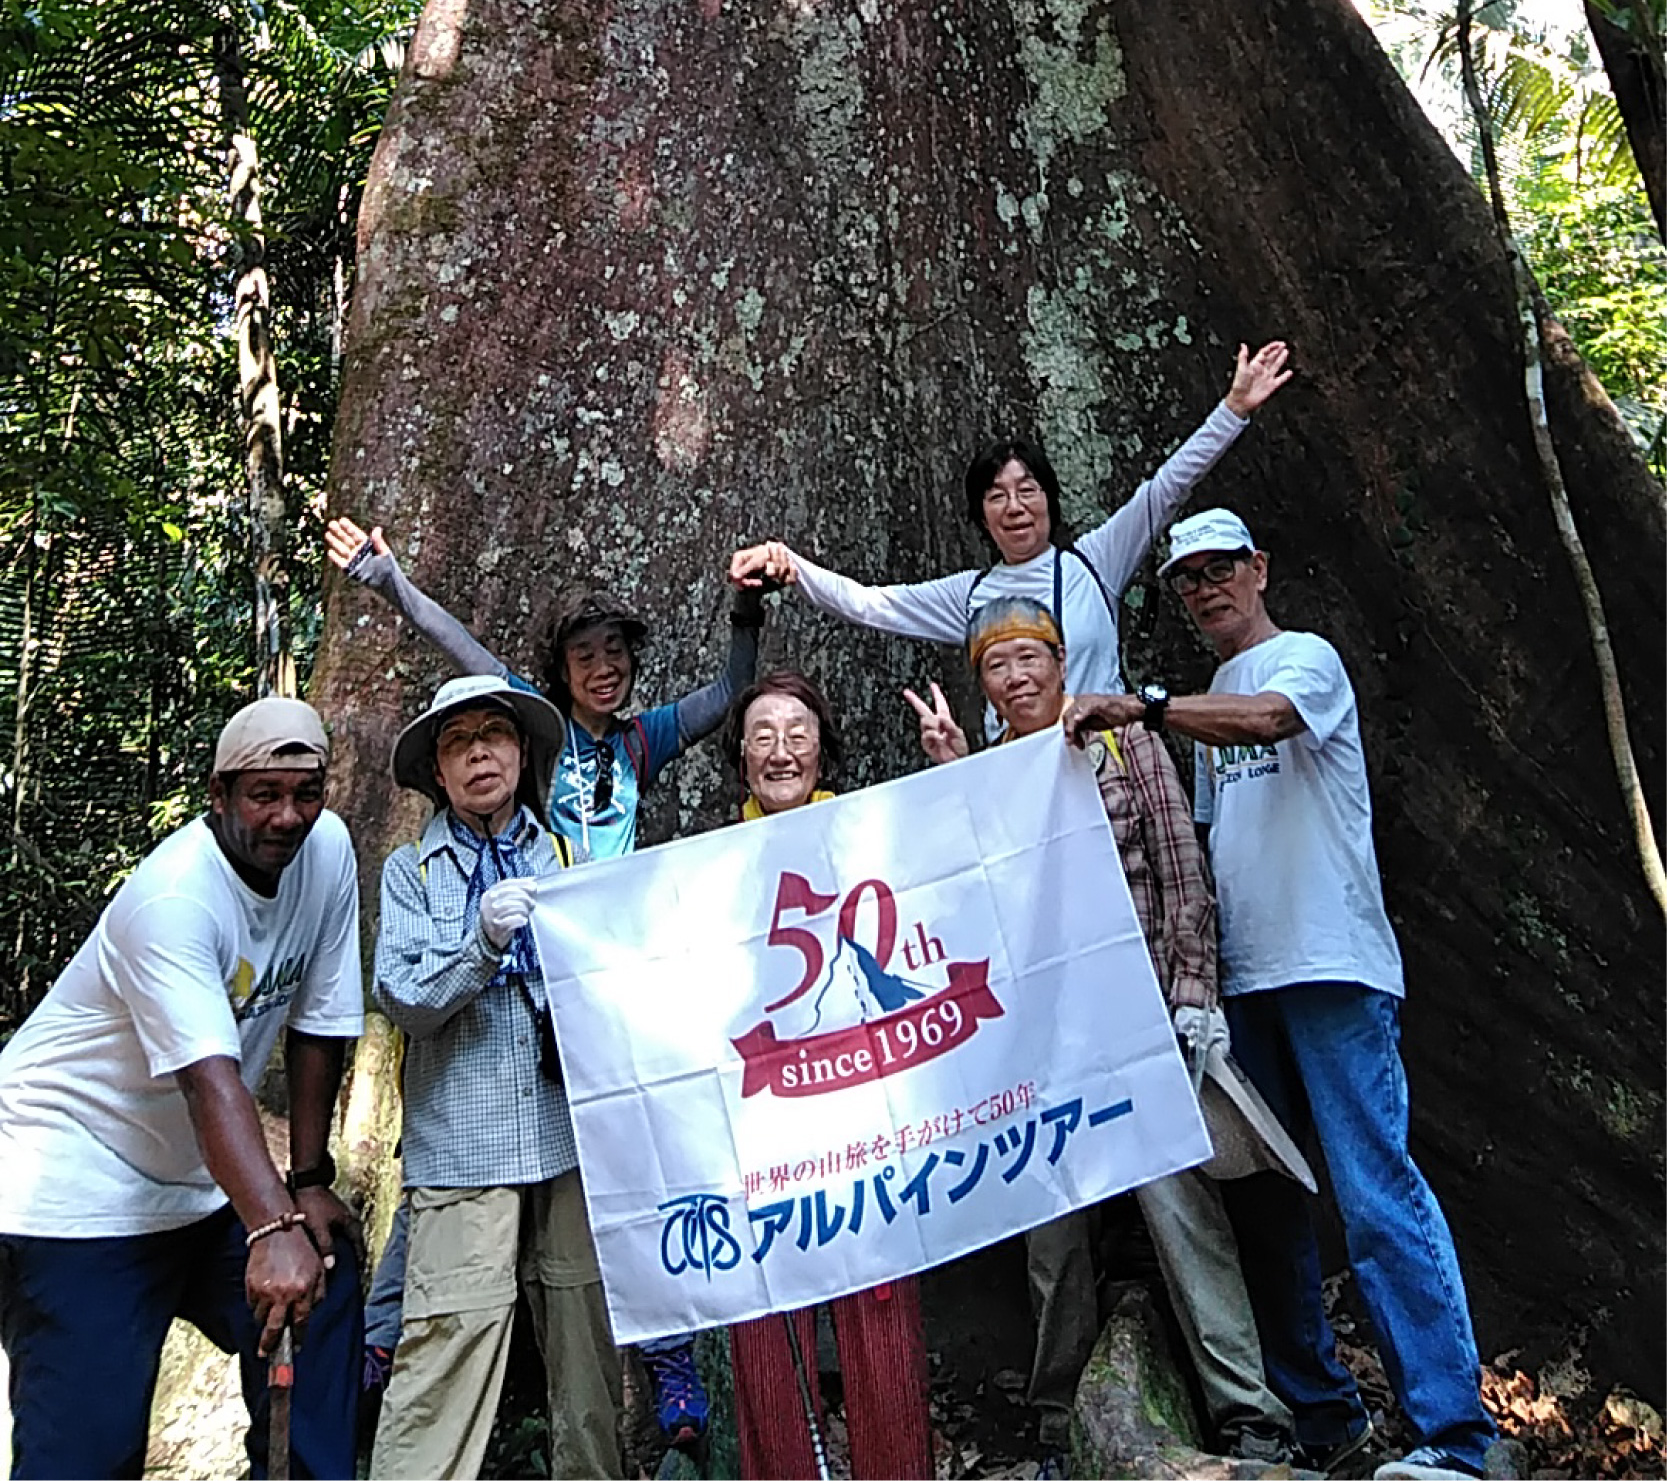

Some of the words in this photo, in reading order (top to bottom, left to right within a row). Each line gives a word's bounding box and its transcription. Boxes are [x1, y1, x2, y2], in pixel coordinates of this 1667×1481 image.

[781, 1048, 872, 1088] since
[875, 999, 963, 1067] 1969
[748, 1096, 1134, 1264] アルパインツアー
